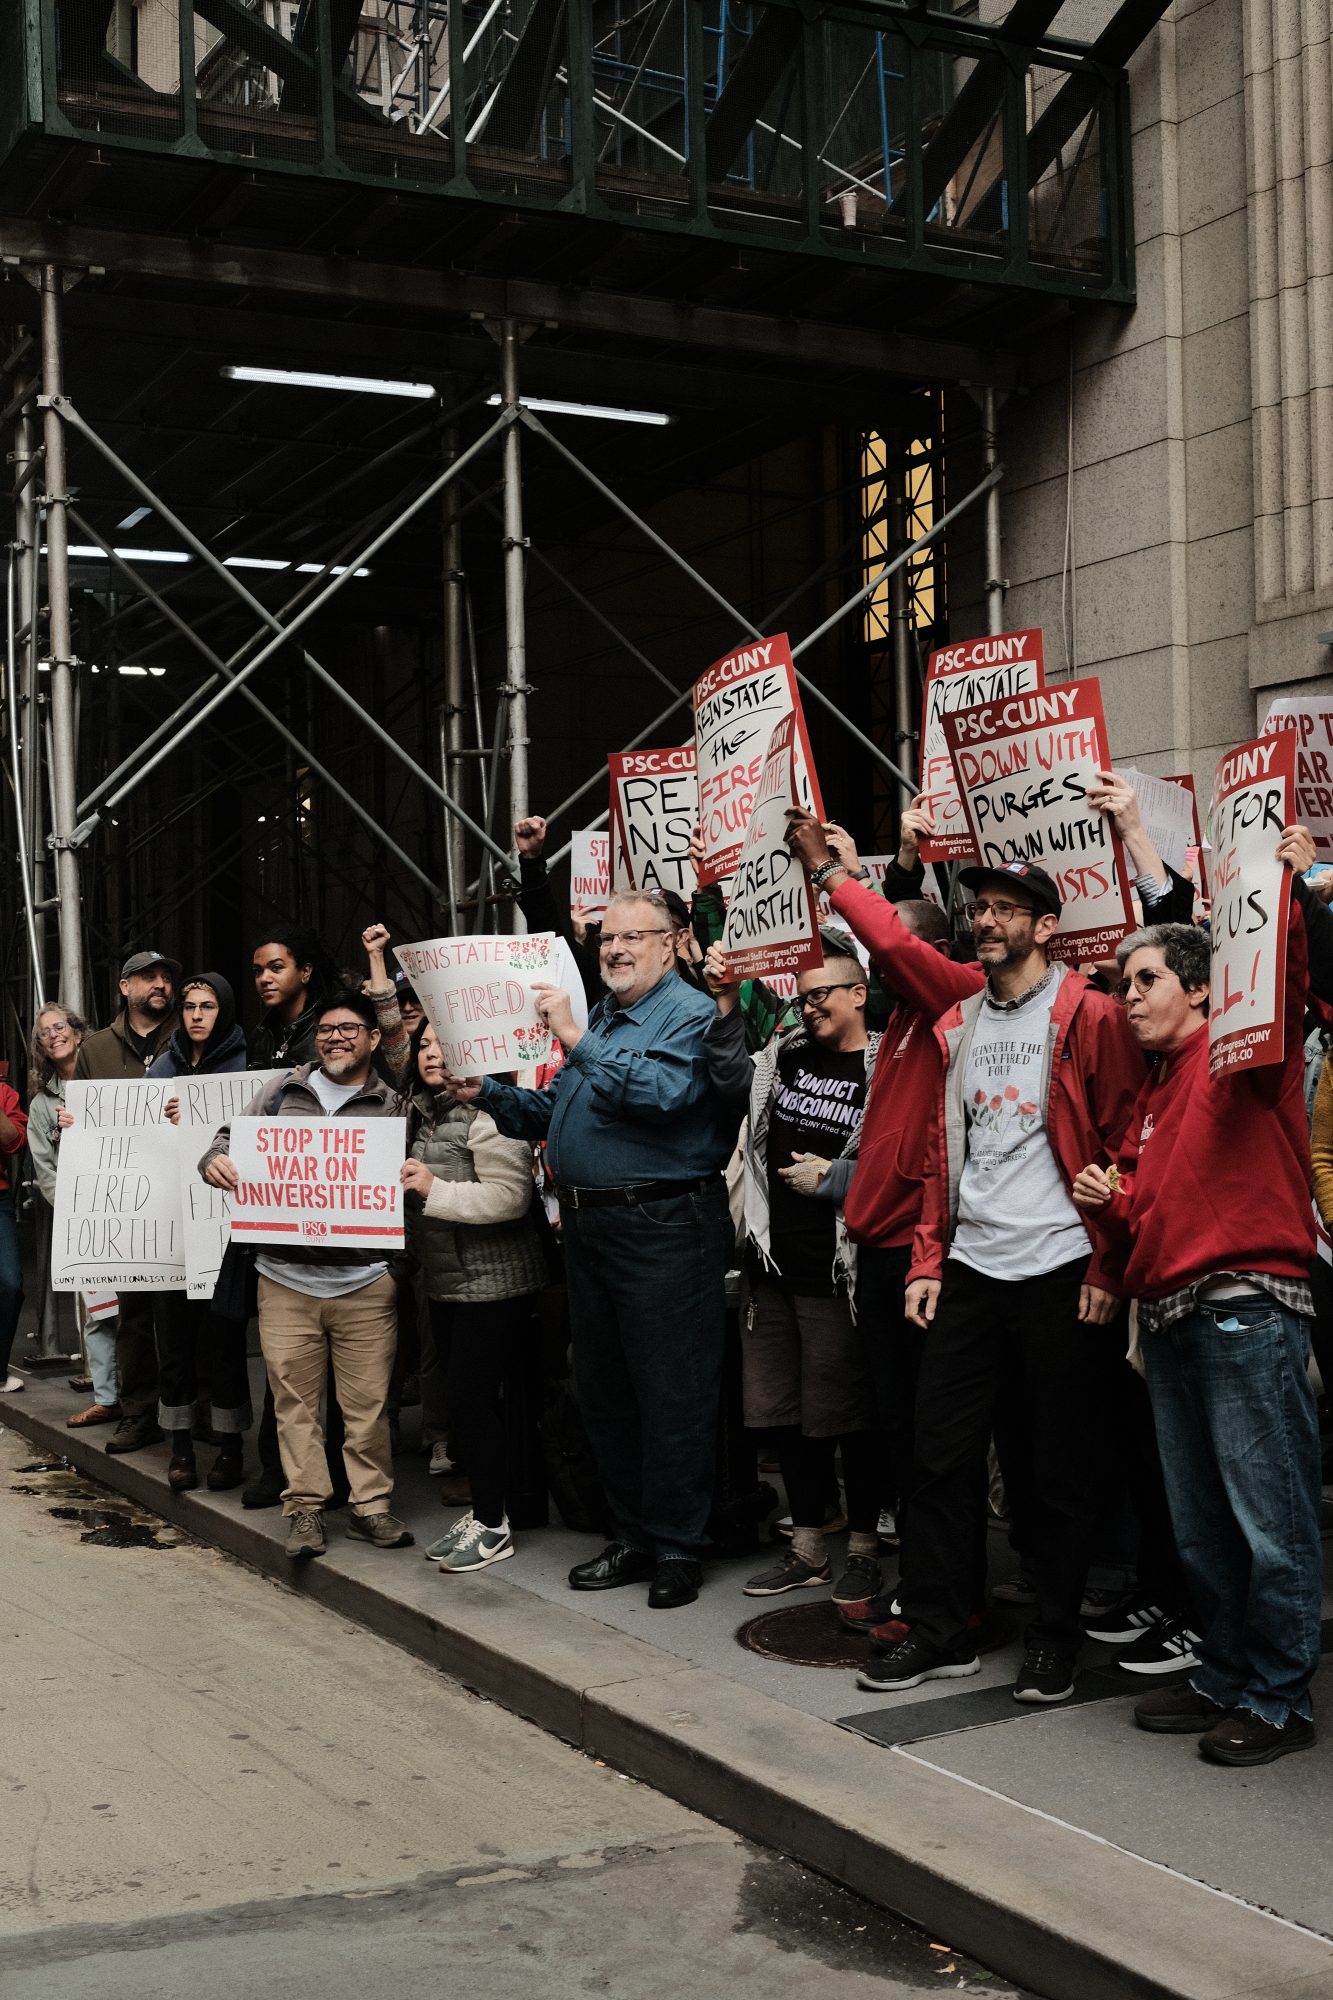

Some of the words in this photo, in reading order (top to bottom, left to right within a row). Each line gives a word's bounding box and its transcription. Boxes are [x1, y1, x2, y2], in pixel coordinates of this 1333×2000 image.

[696, 642, 773, 704] PSC-CUNY
[935, 636, 1028, 674] PSC-CUNY
[697, 673, 782, 740] REINSTATE
[954, 688, 1080, 742] PSC-CUNY
[709, 729, 760, 768] the
[959, 739, 1028, 788] DOWN
[1035, 727, 1100, 771] WITH
[622, 776, 699, 818] RE
[701, 754, 763, 812] FIRE
[973, 772, 1088, 833] PURGES
[1230, 788, 1287, 843] FOR
[948, 847, 962, 855] AFT
[983, 829, 1044, 869] DOWN
[1048, 816, 1106, 851] WITH
[728, 886, 805, 949] FOURTH!
[1228, 889, 1268, 939] US
[763, 942, 811, 959] Congress/CUNY
[1052, 949, 1072, 960] 2334
[1077, 943, 1109, 957] AFL-CIO
[1061, 929, 1125, 948] Congress/CUNY
[774, 956, 799, 968] AFL-CIO
[445, 980, 525, 1024] FIRED
[1000, 1053, 1031, 1065] FIRED
[1021, 1042, 1045, 1055] THE
[1226, 1048, 1254, 1065] AFL-CIO
[84, 1084, 174, 1129] REHIRE
[256, 1127, 313, 1153] STOP
[319, 1128, 366, 1154] THE
[799, 1118, 821, 1129] CUNY
[820, 1123, 840, 1134] Fired
[96, 1135, 141, 1169] THE
[267, 1155, 318, 1181] WAR
[325, 1156, 358, 1182] ON
[74, 1174, 151, 1213] FIRED
[233, 1182, 397, 1213] UNIVERSITIES!
[302, 1221, 328, 1236] PSC
[305, 1235, 325, 1243] CUNY
[53, 1276, 75, 1286] CUNY
[80, 1274, 166, 1285] INTERNATIONALIST
